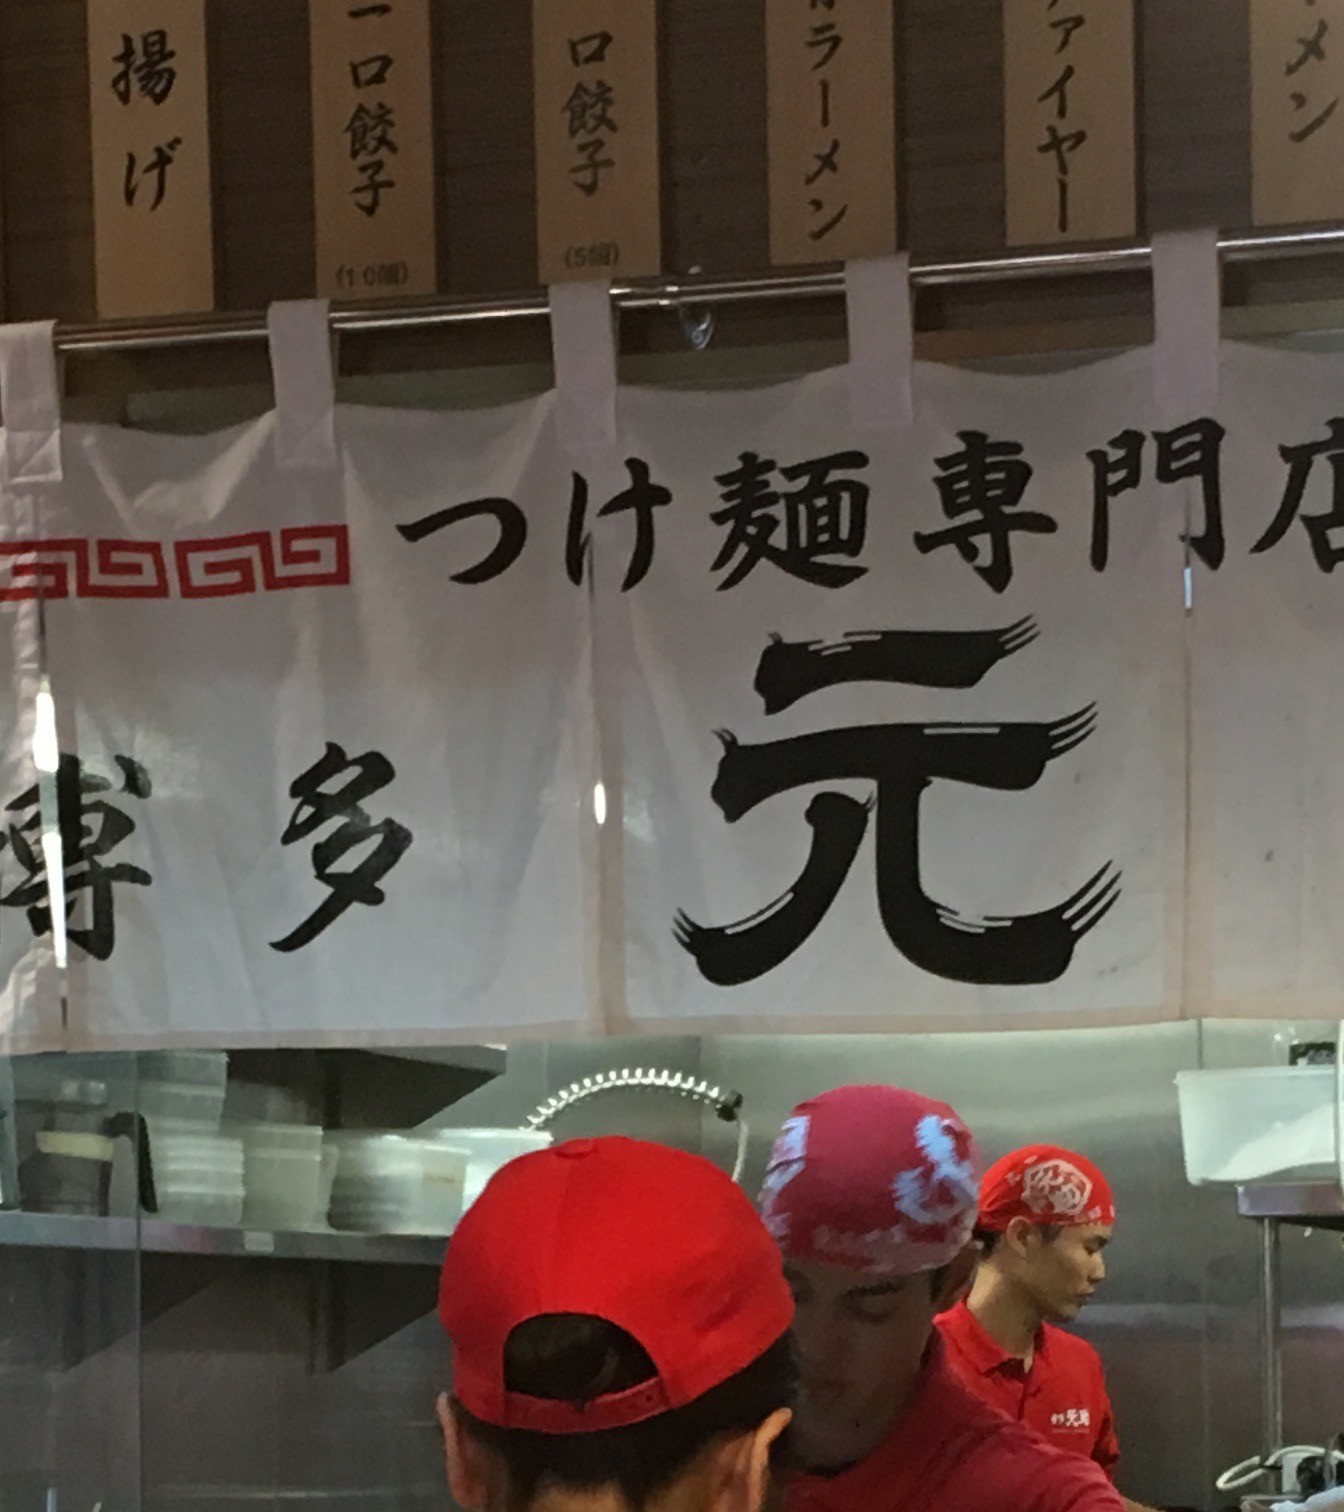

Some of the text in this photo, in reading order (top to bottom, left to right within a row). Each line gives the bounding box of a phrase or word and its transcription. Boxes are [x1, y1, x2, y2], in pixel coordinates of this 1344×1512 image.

[112, 28, 183, 211] 揚げ
[804, 0, 848, 241] ラーメン
[1037, 0, 1087, 233] ァイヤー
[1285, 0, 1340, 143] メン
